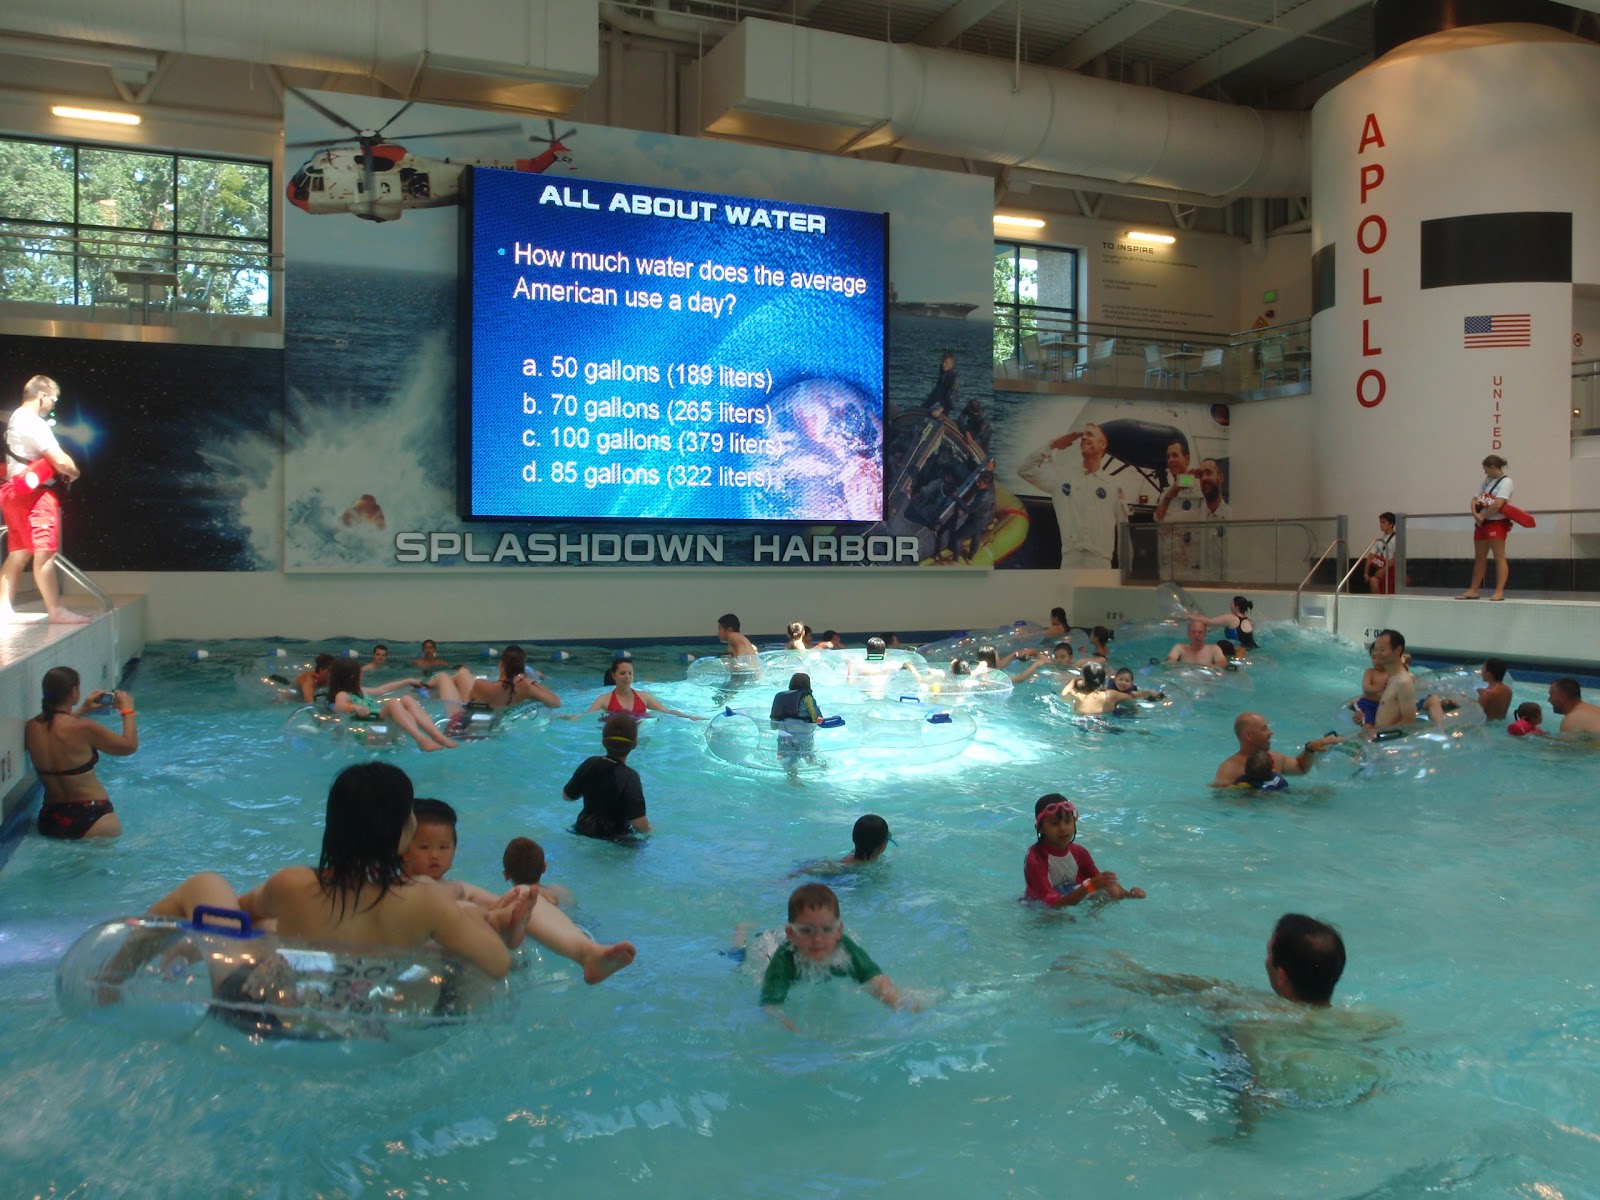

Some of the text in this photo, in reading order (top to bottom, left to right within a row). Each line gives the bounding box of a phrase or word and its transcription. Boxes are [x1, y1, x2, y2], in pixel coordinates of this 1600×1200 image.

[538, 185, 826, 234] ALL ABOUT WATER
[1102, 241, 1154, 255] TO INSPIRE
[1356, 112, 1387, 408] APOLLO
[514, 242, 867, 298] How much water does the average
[512, 276, 737, 318] American use a day?
[522, 356, 773, 394] a. 50 gallons (189 liters)
[522, 392, 772, 429] b. 70 gallons (265 liters)
[1492, 376, 1503, 449] UNITED
[522, 427, 783, 459] c. 100 gallons (379 liters)
[522, 460, 773, 492] d. 85 gallons (322 liters)
[395, 532, 919, 562] SPLASHDOWN HARBOR
